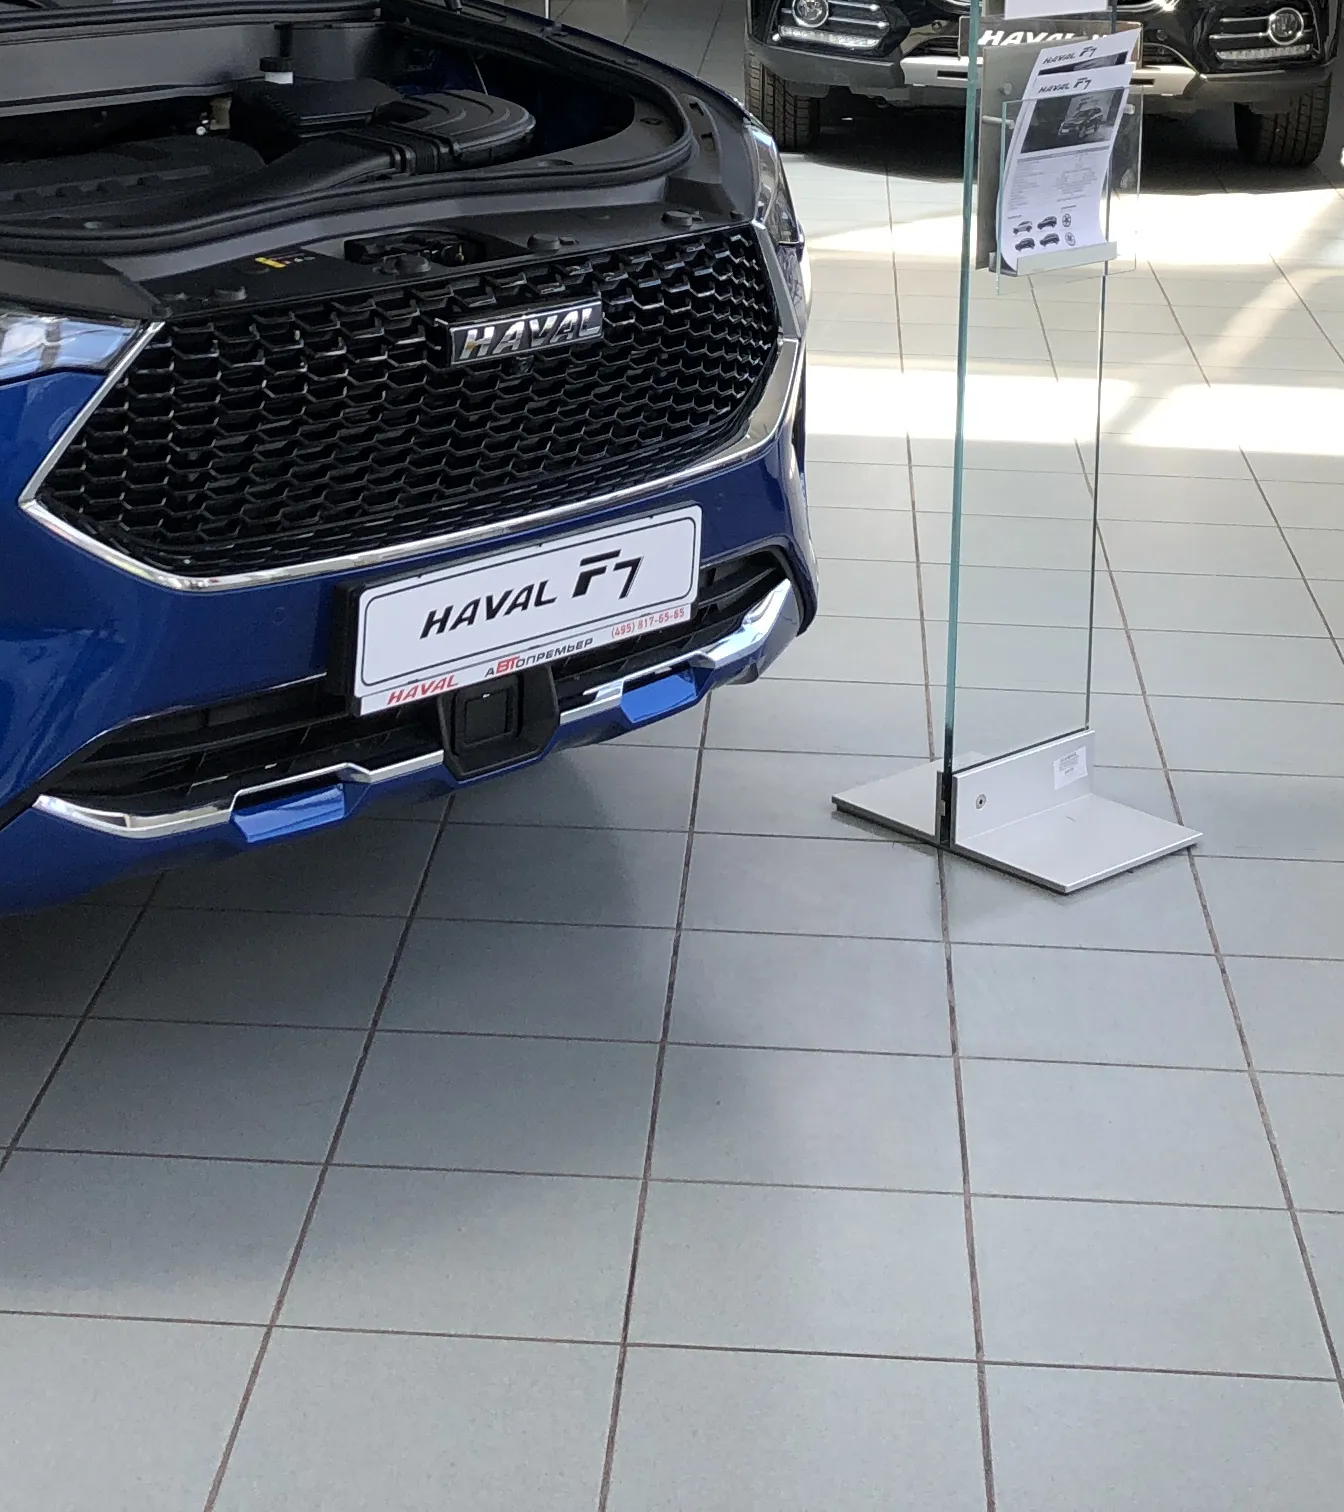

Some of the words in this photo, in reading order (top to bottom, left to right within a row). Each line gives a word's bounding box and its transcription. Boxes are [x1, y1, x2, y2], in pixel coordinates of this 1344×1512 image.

[1042, 53, 1075, 64] HAVAL
[1079, 45, 1097, 57] F7
[1038, 82, 1070, 93] HAVAL
[1073, 77, 1092, 89] F7
[459, 308, 602, 360] HAVAL
[420, 579, 557, 639] HAVAL
[571, 548, 644, 599] F7
[386, 675, 459, 705] HAVAL
[610, 621, 636, 639] (495)
